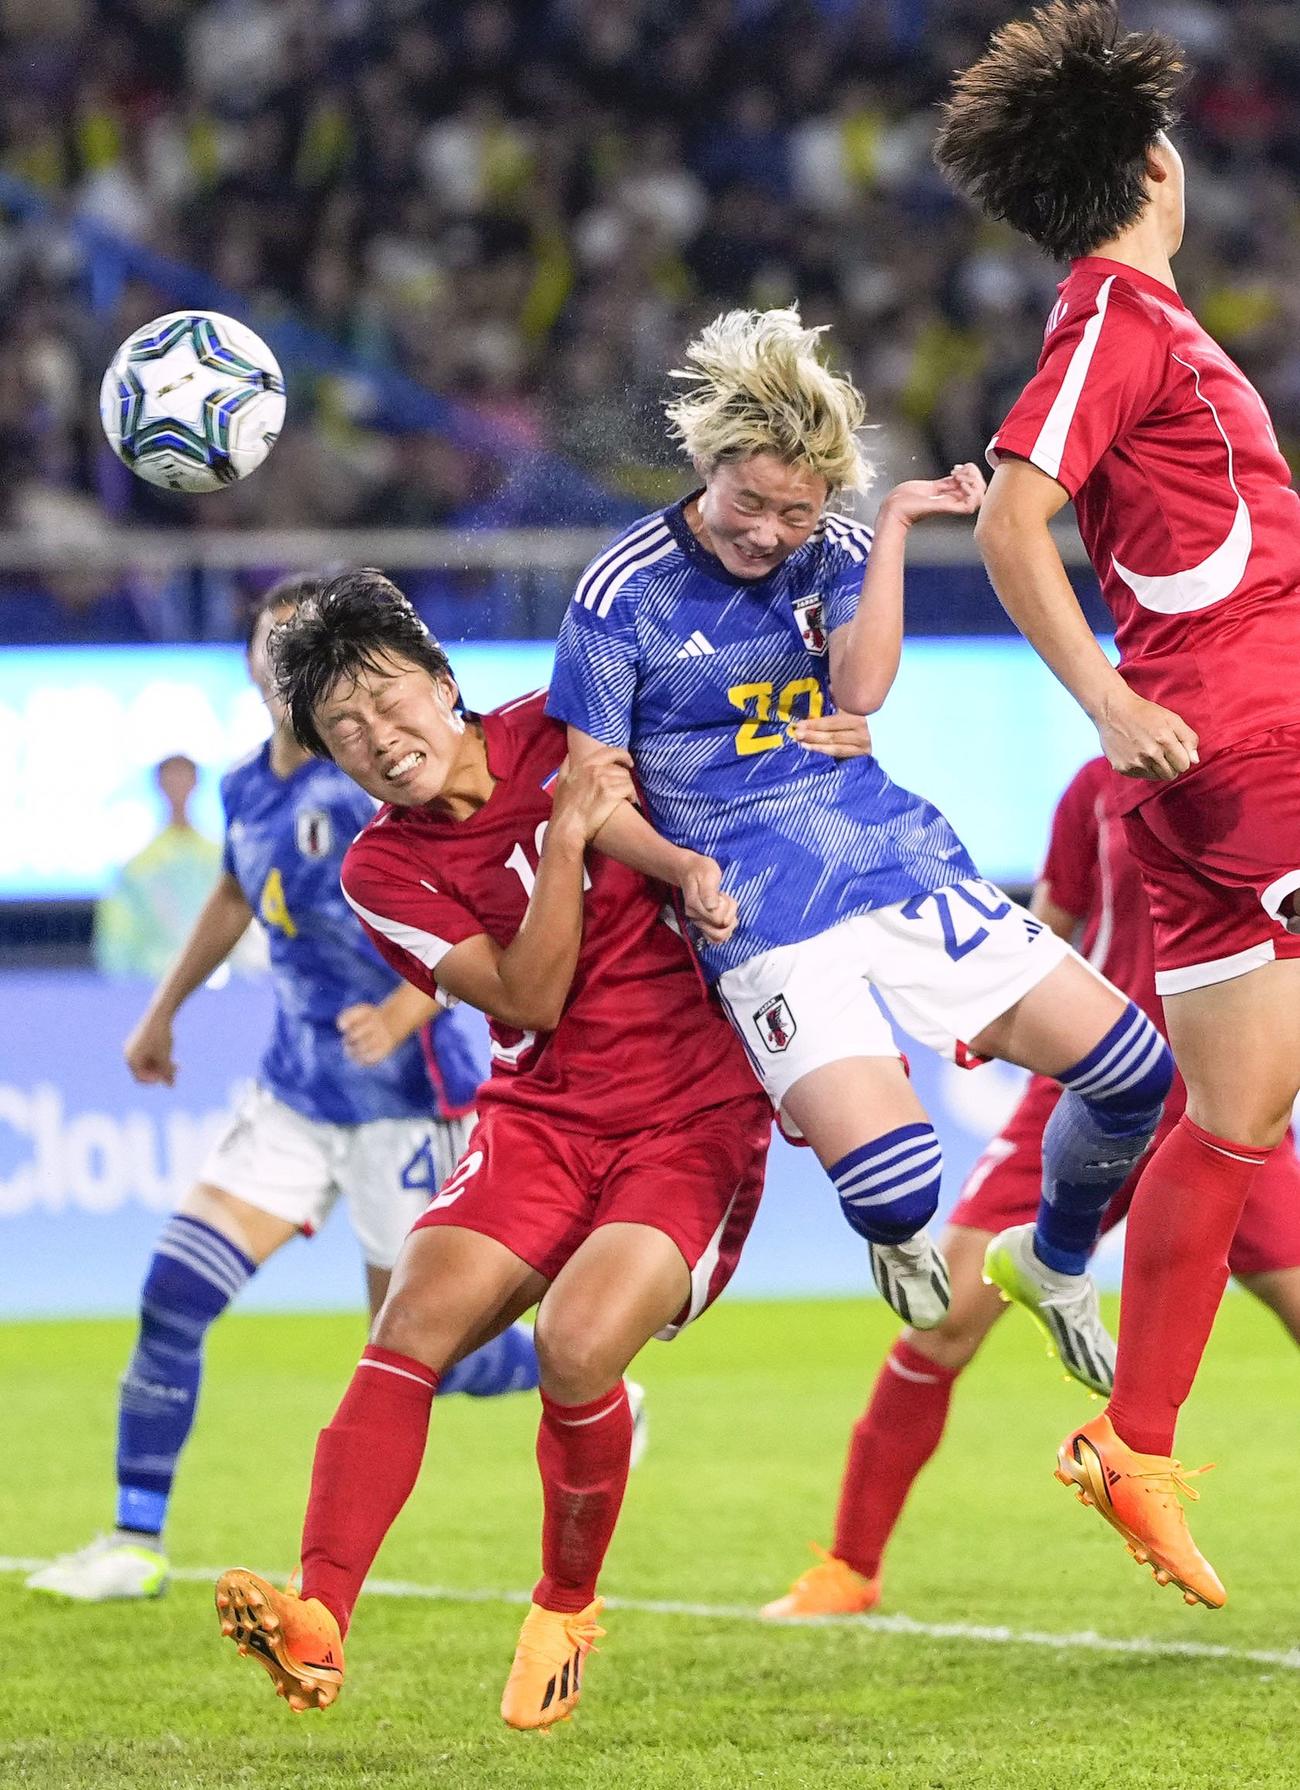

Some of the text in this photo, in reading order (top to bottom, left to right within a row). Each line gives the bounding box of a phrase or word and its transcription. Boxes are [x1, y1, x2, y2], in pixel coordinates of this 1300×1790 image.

[728, 677, 824, 756] 20
[261, 867, 298, 938] 4
[504, 820, 593, 910] 1
[401, 1135, 437, 1198] 4
